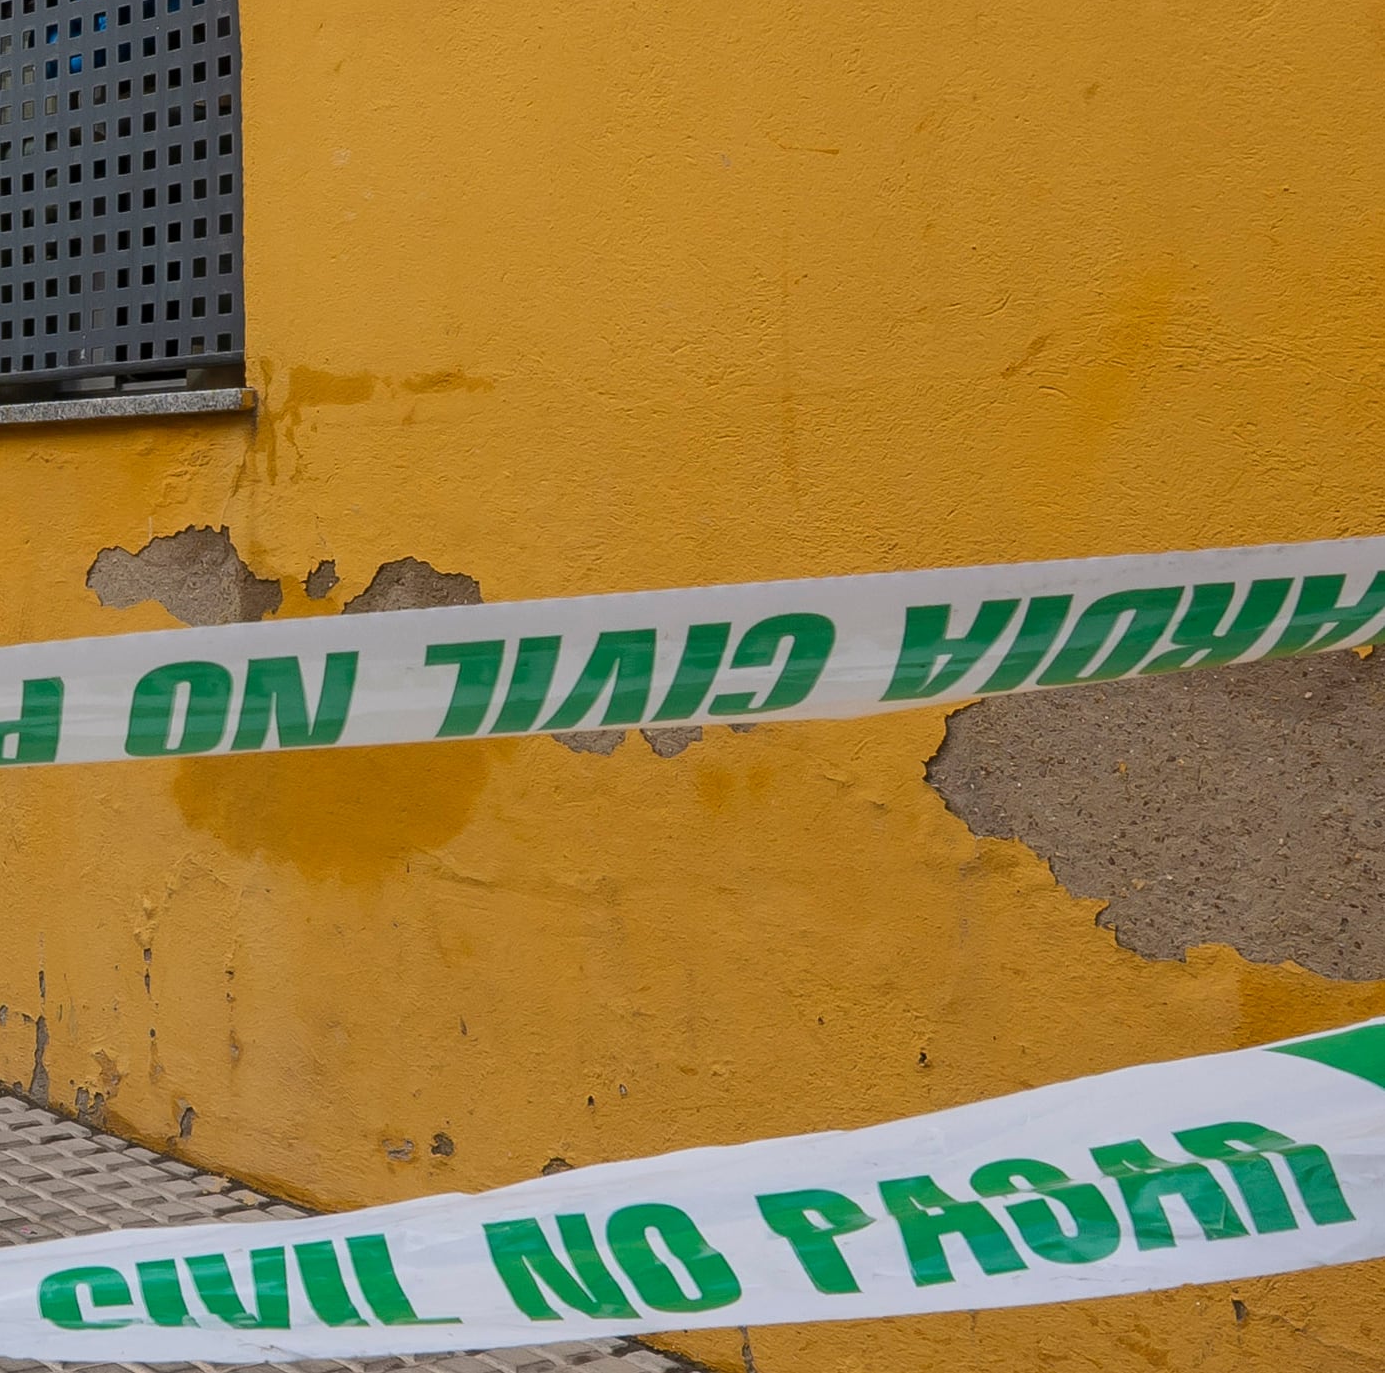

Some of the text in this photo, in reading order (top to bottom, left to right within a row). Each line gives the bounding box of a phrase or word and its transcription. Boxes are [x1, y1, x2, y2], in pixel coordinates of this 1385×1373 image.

[125, 651, 358, 756] NO
[426, 612, 838, 737] CIVIL
[37, 1232, 463, 1332] CIVIL
[483, 1201, 744, 1319] NO
[756, 1120, 1357, 1294] PASAR
